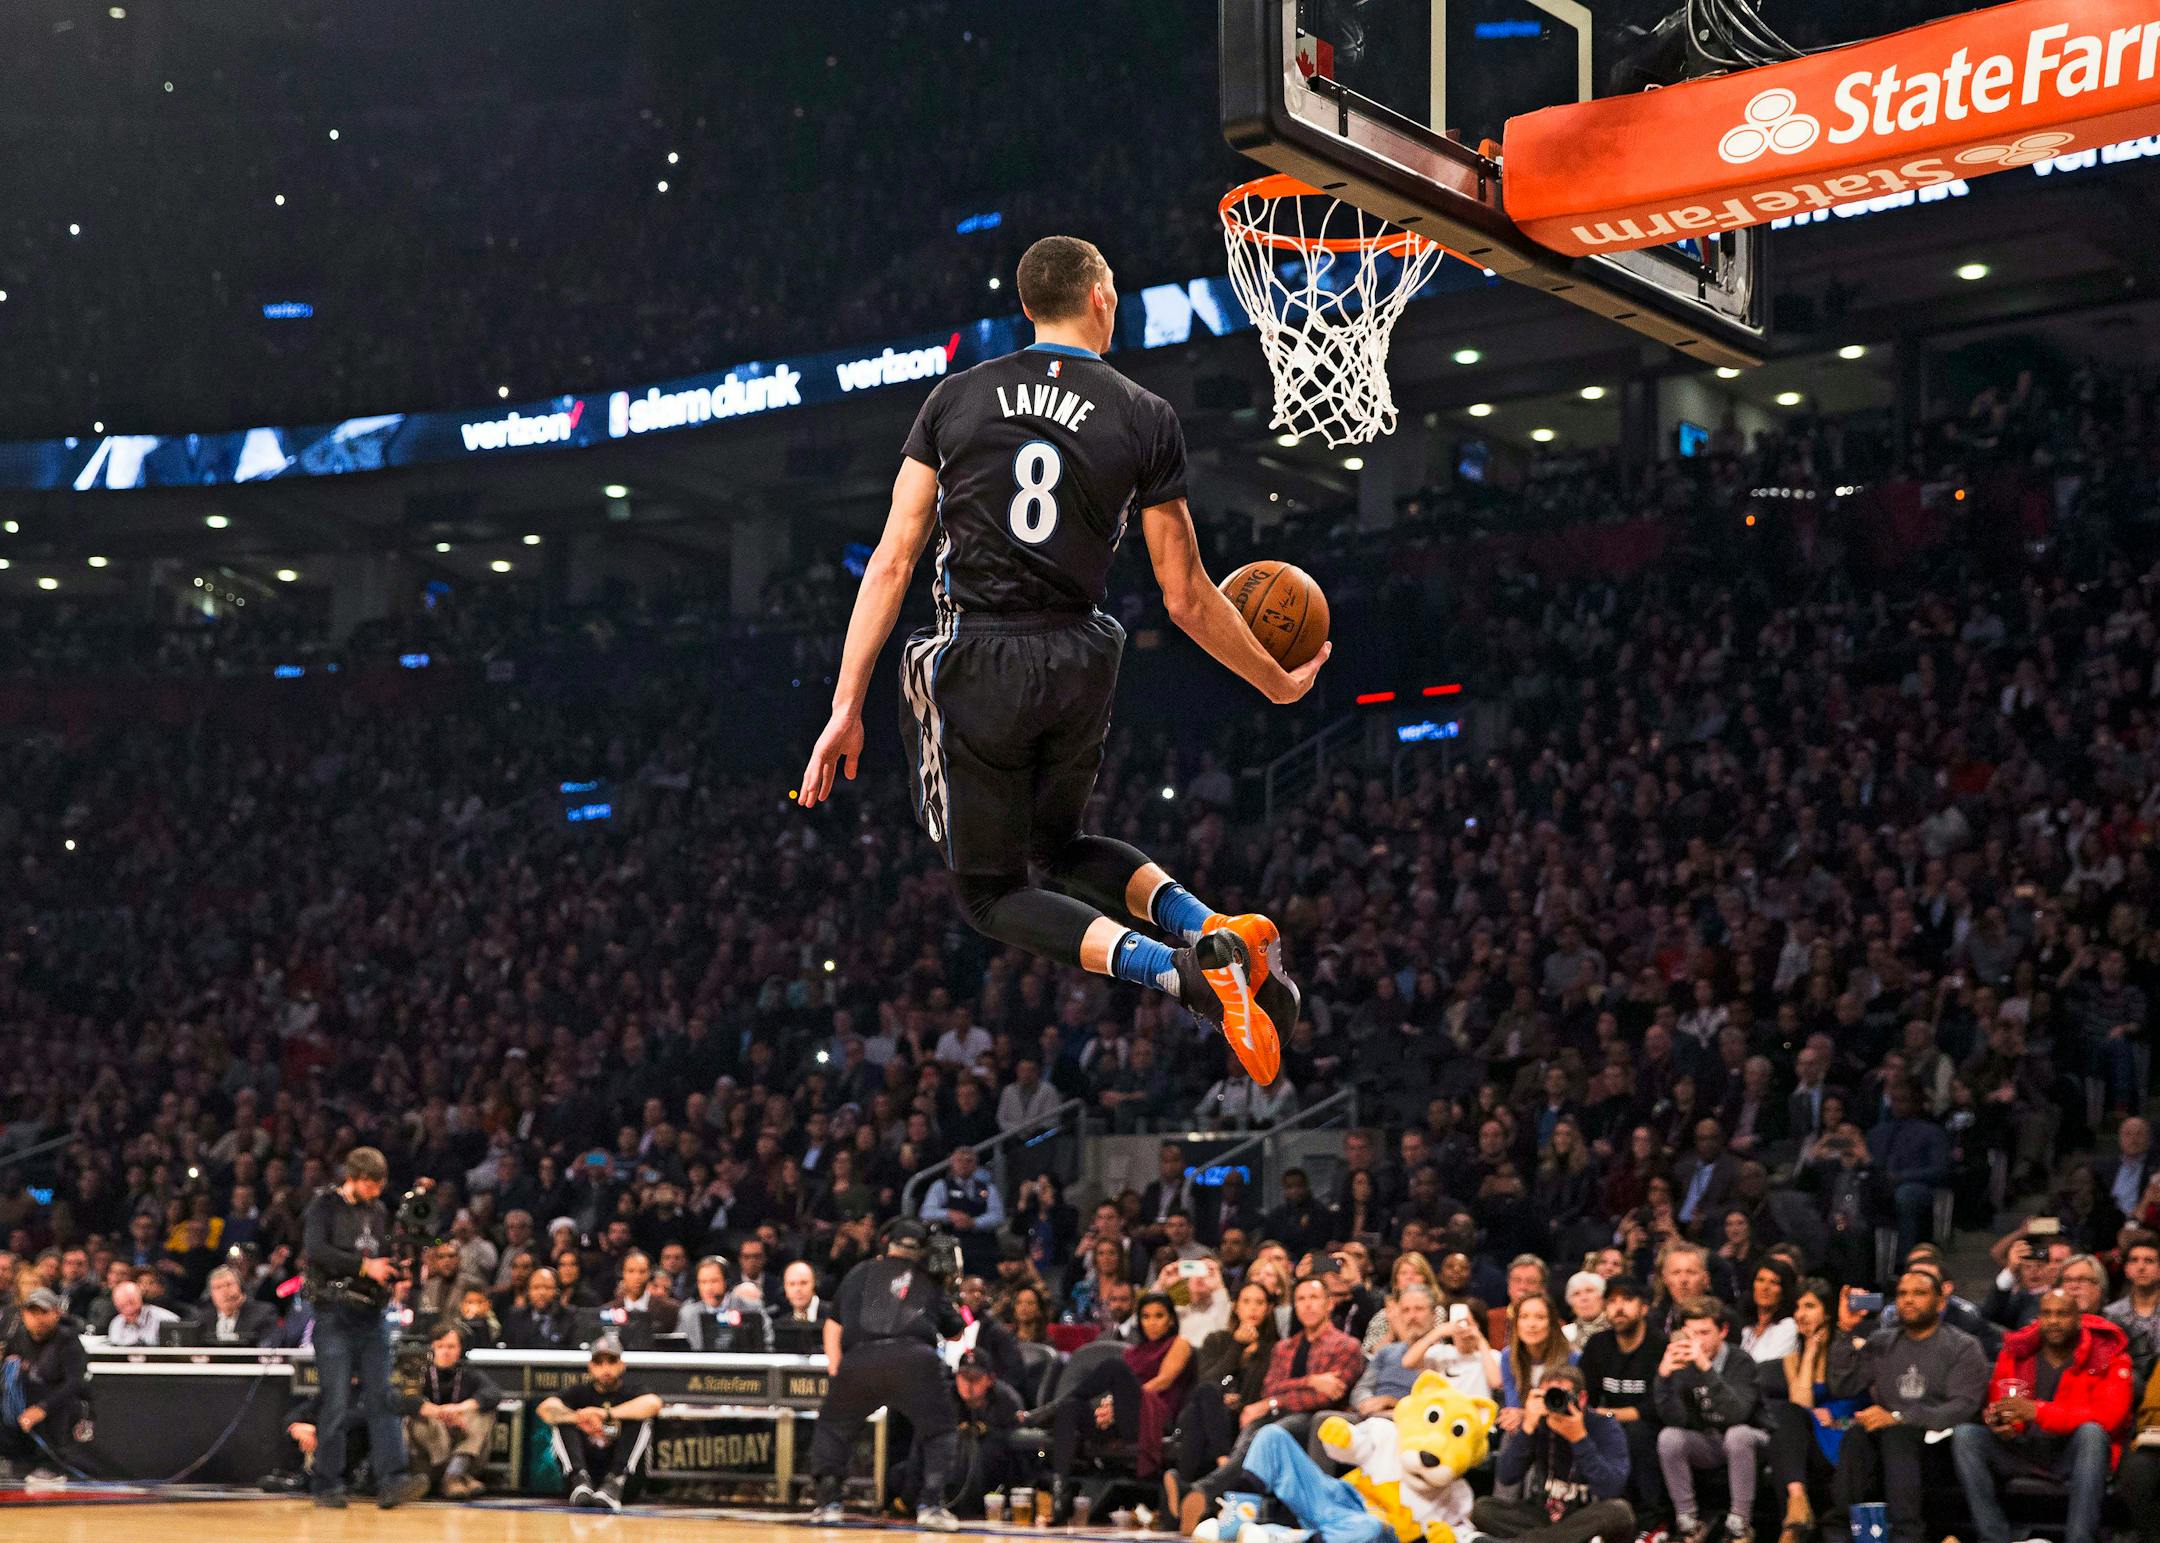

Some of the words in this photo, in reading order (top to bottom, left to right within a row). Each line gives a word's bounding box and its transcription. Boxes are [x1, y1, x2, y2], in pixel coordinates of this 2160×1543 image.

[1827, 46, 2014, 144] State
[1752, 157, 1955, 212] State
[1570, 199, 1758, 245] Farm
[711, 364, 801, 419] dunk
[836, 344, 947, 392] verizon
[460, 411, 572, 452] verizon
[996, 383, 1096, 433] LAVINE
[1007, 439, 1064, 546] 8
[657, 1431, 771, 1470] SATURDAY
